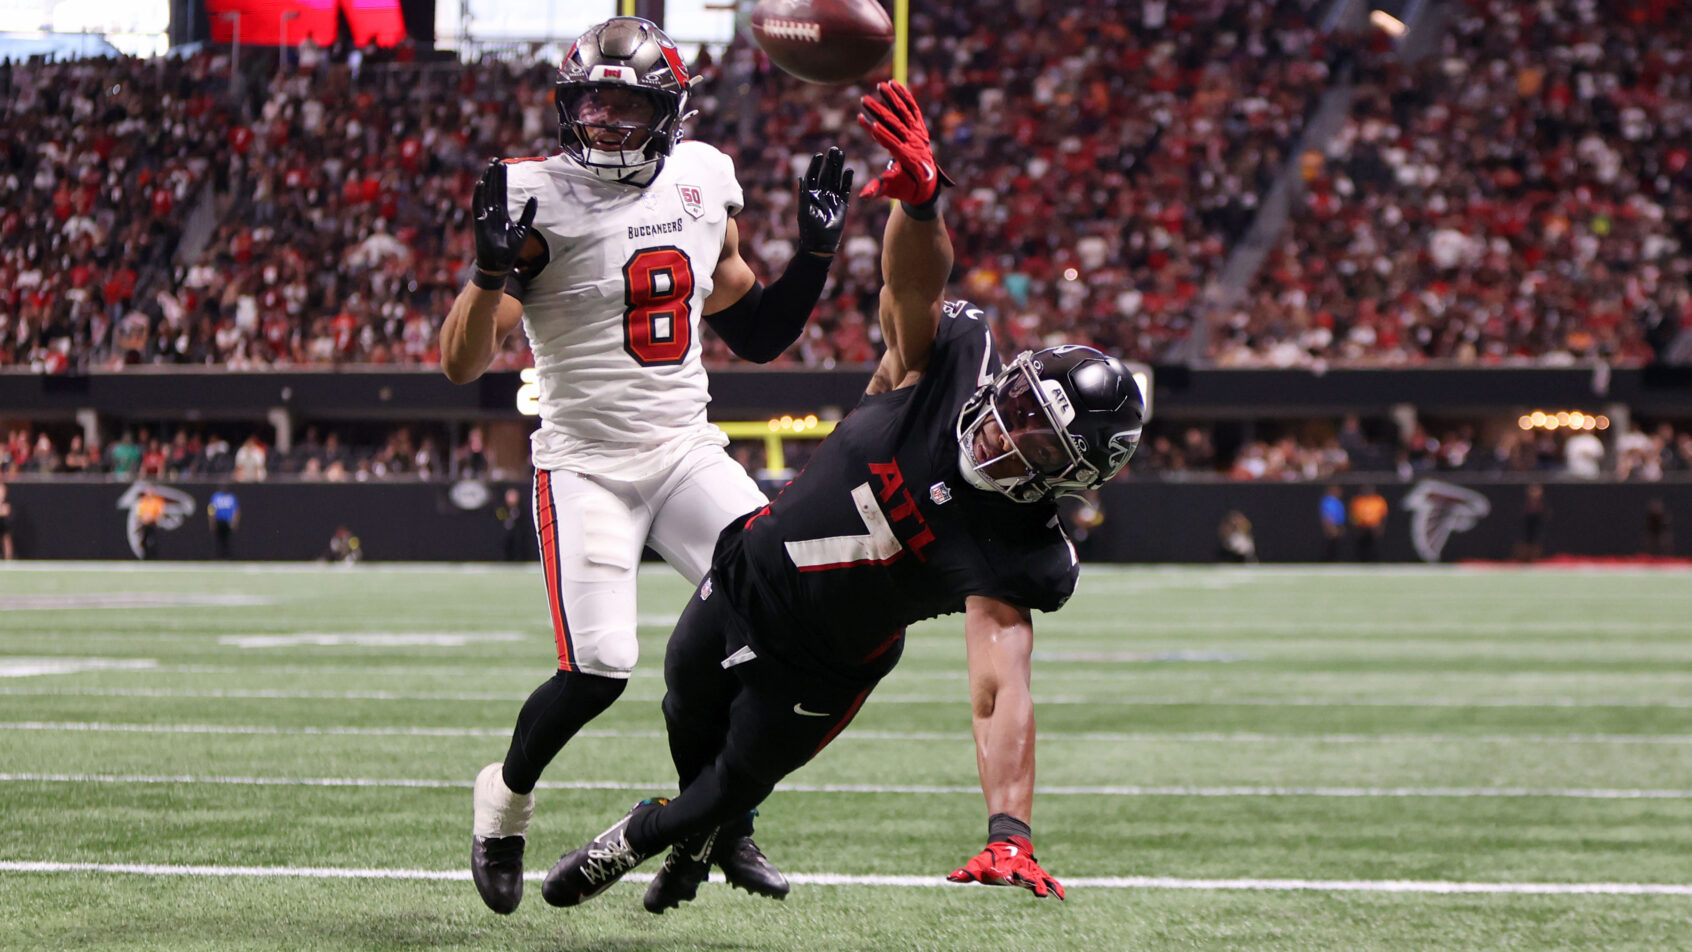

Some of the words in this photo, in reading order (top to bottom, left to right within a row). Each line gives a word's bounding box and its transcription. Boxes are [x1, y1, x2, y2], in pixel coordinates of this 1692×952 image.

[680, 187, 701, 204] 50
[628, 217, 683, 239] BUCCANEERS
[622, 245, 695, 367] 8
[1051, 388, 1069, 415] ATL
[784, 481, 906, 573] 7
[868, 456, 937, 563] ATL
